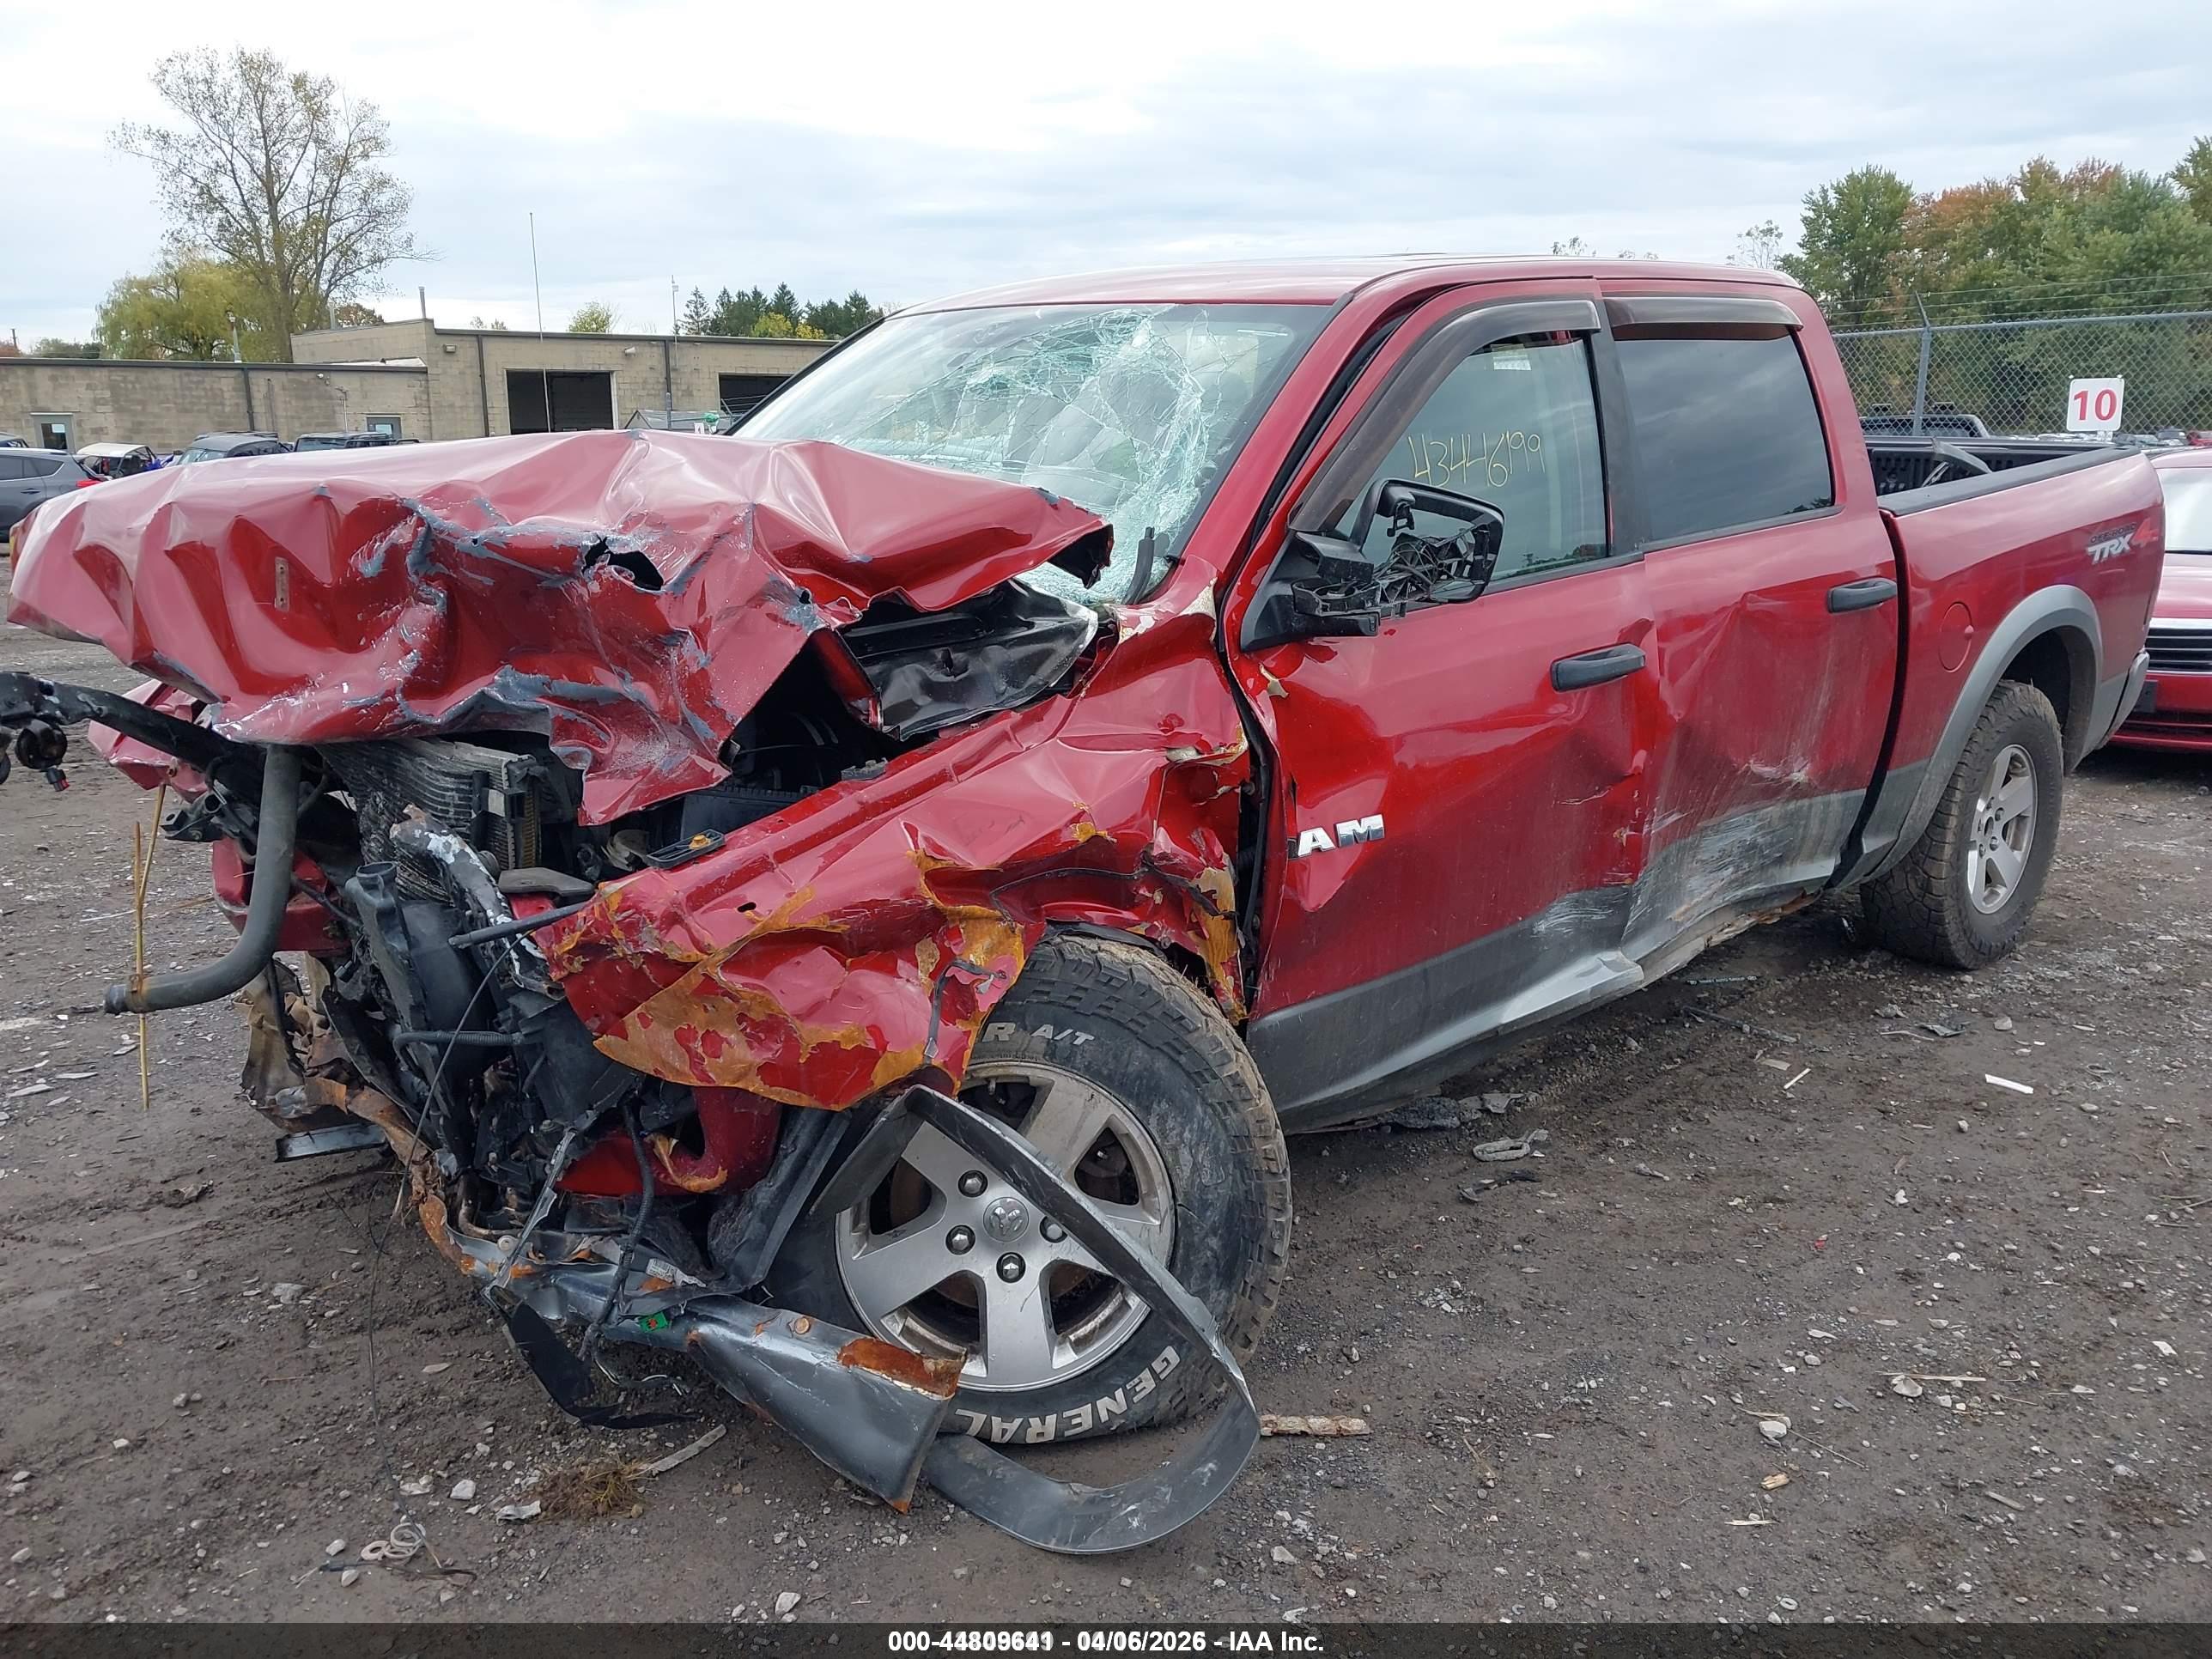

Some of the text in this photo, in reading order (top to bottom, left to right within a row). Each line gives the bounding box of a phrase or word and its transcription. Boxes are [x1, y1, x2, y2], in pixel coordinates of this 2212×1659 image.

[2073, 389, 2118, 421] 10
[1407, 430, 1546, 488] 43446199
[1030, 1024, 1095, 1046] A/T
[955, 1345, 1182, 1445] GENERAL
